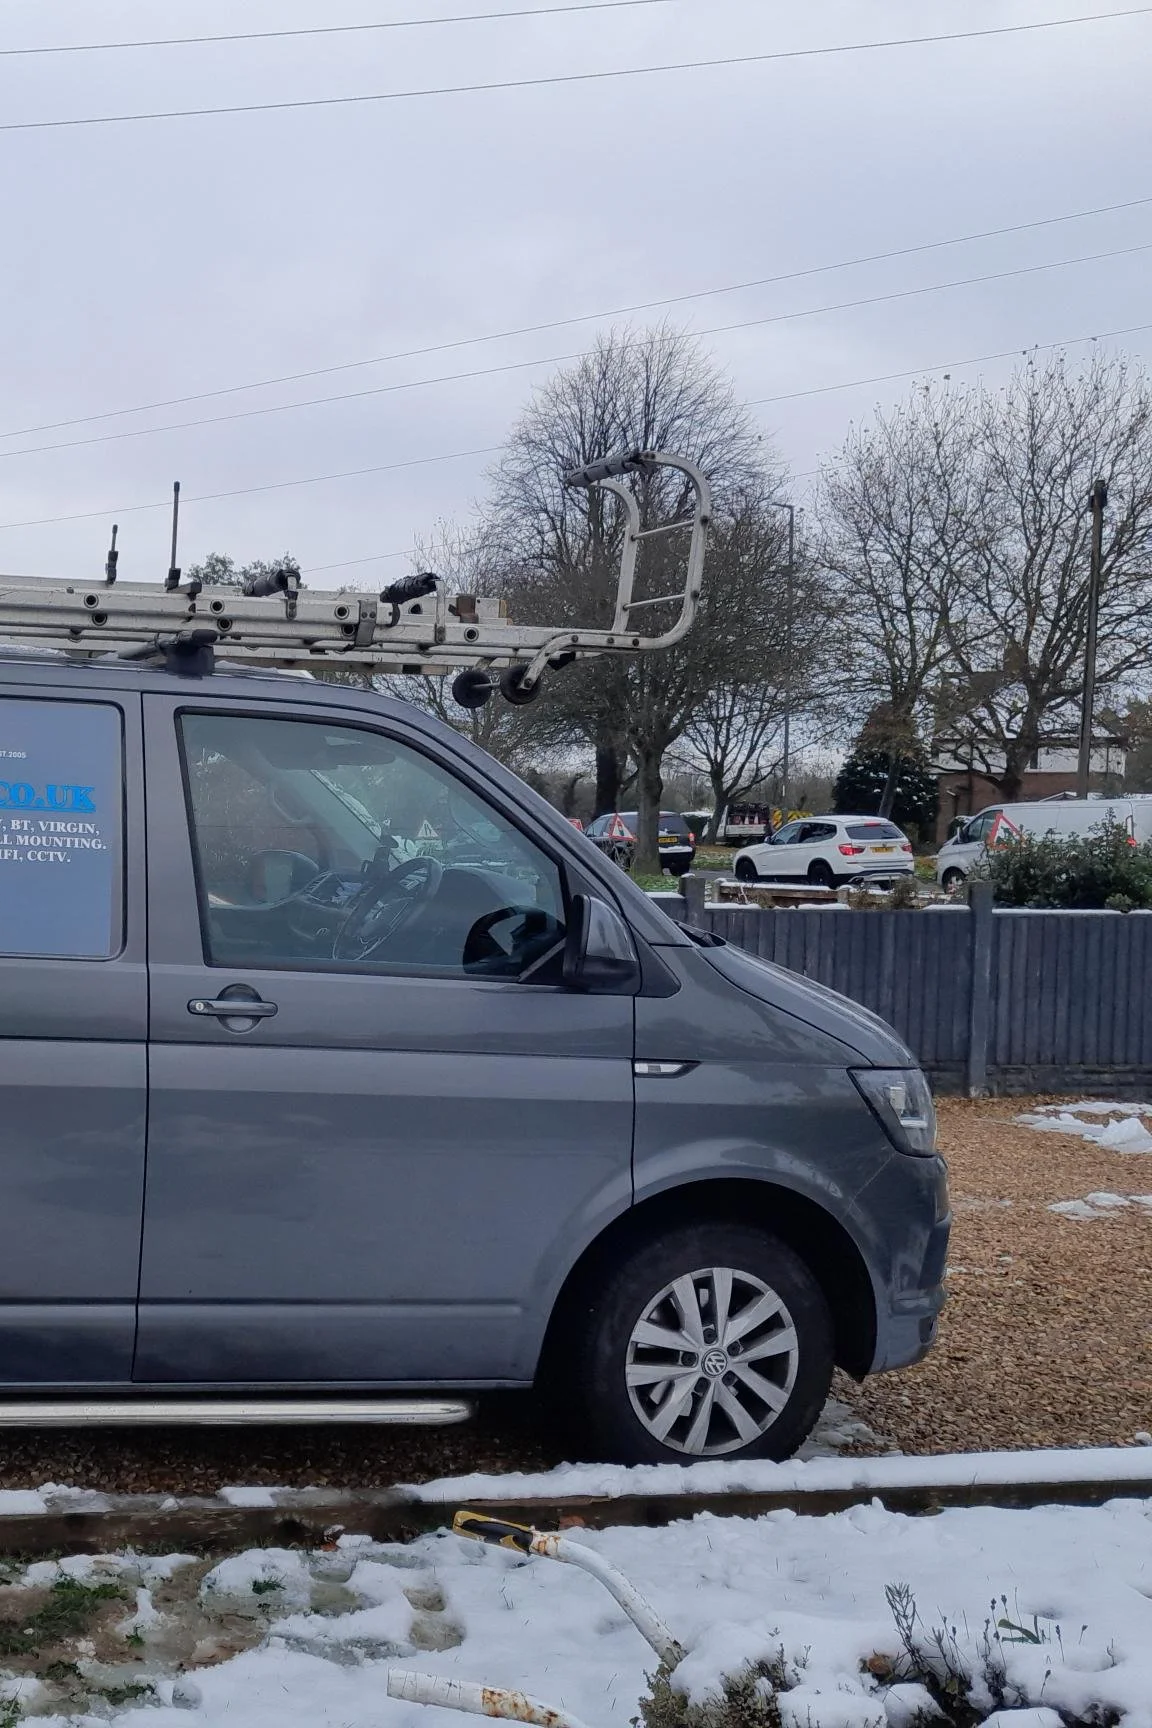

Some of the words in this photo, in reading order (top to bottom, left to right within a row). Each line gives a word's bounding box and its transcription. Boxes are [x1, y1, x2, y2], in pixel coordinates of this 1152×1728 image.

[11, 819, 35, 833] BT,
[38, 820, 100, 836] VIRGIN,
[15, 834, 107, 850] MOUNTING.
[27, 851, 71, 863] CCTV.
